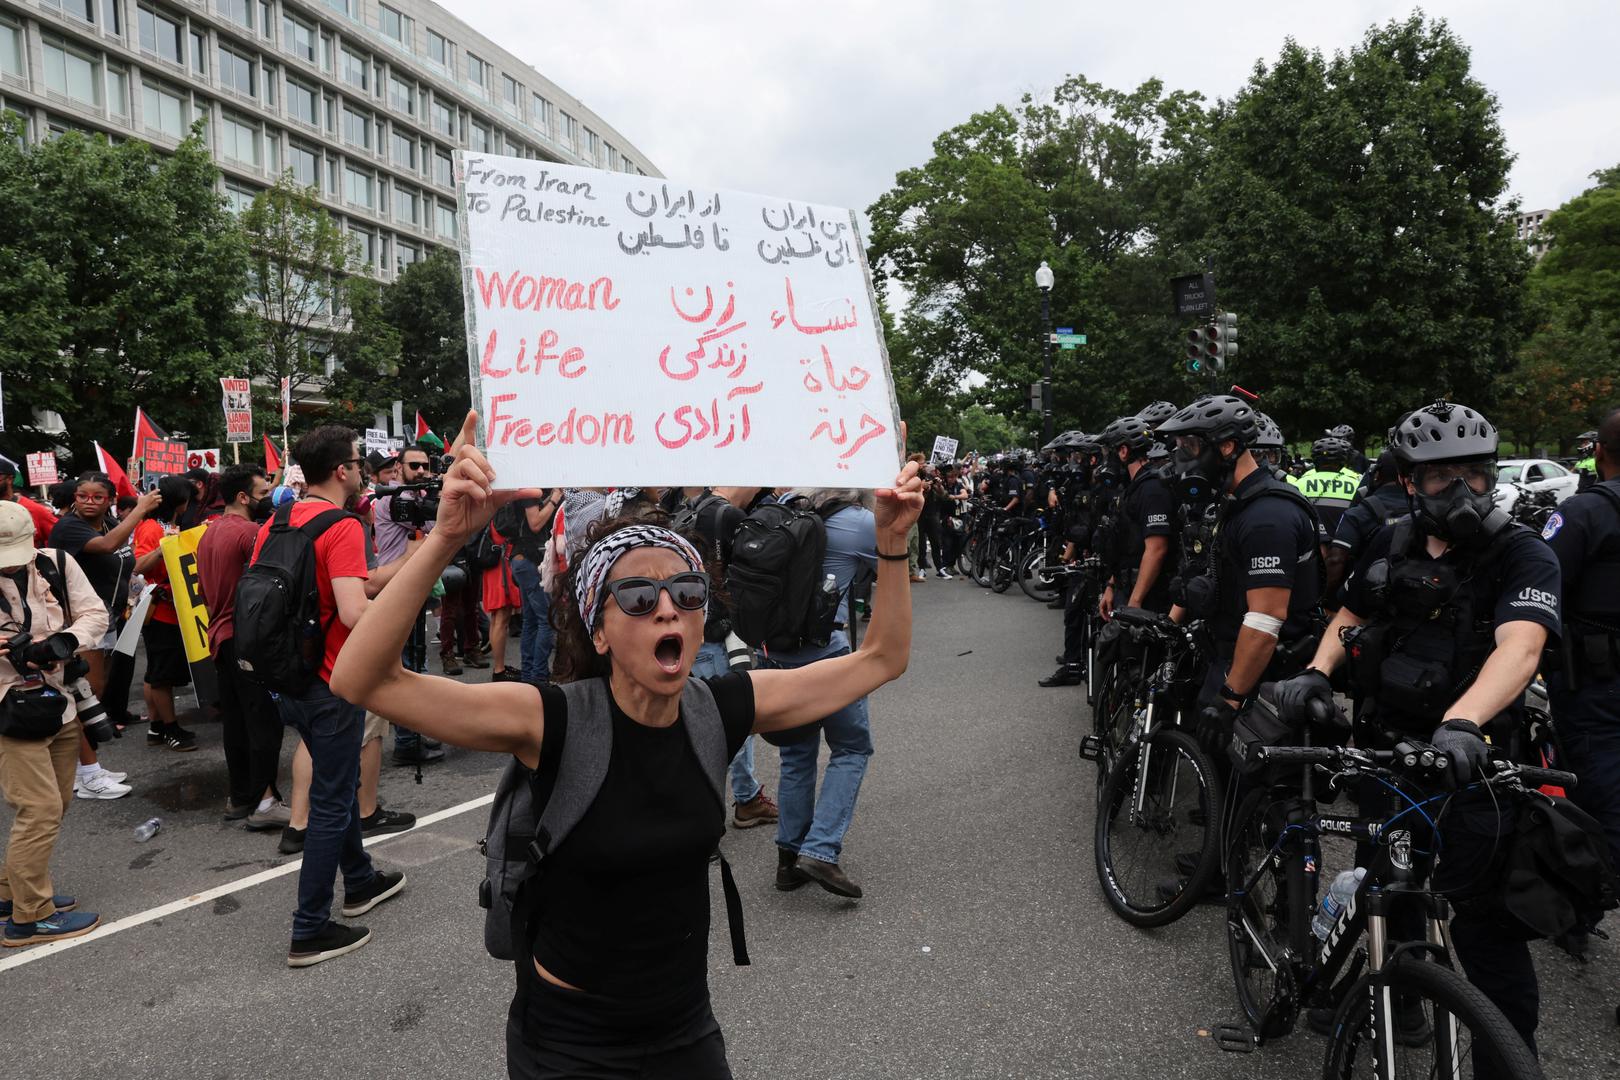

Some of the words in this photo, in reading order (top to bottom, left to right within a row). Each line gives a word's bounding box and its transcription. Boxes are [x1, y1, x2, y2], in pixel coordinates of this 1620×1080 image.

[465, 158, 527, 190] From
[534, 170, 597, 201] Iran
[467, 192, 491, 214] To
[500, 193, 611, 228] Palestine
[625, 184, 696, 219] ایران
[699, 192, 721, 218] از
[617, 221, 705, 256] فلسطین
[712, 222, 730, 252] تا
[820, 220, 847, 240] من
[475, 267, 621, 312] Woman
[671, 281, 736, 327] زن
[770, 276, 858, 335] نساء
[1196, 302, 1208, 310] LEFT
[480, 328, 587, 379] Life
[659, 321, 747, 381] زندگی
[800, 344, 872, 400] حياة
[486, 393, 635, 448] Freedom
[654, 380, 764, 450] آزادی
[145, 440, 166, 452] END
[168, 442, 185, 454] ALL
[809, 406, 888, 470] حرية
[145, 459, 185, 474] ISRAEL
[161, 453, 174, 462] AID
[175, 454, 185, 463] TO
[1306, 479, 1354, 494] NYPD
[1148, 514, 1167, 522] USCP
[1251, 556, 1280, 568] USCP
[1518, 587, 1558, 608] USCP
[1320, 820, 1352, 832] POLICE
